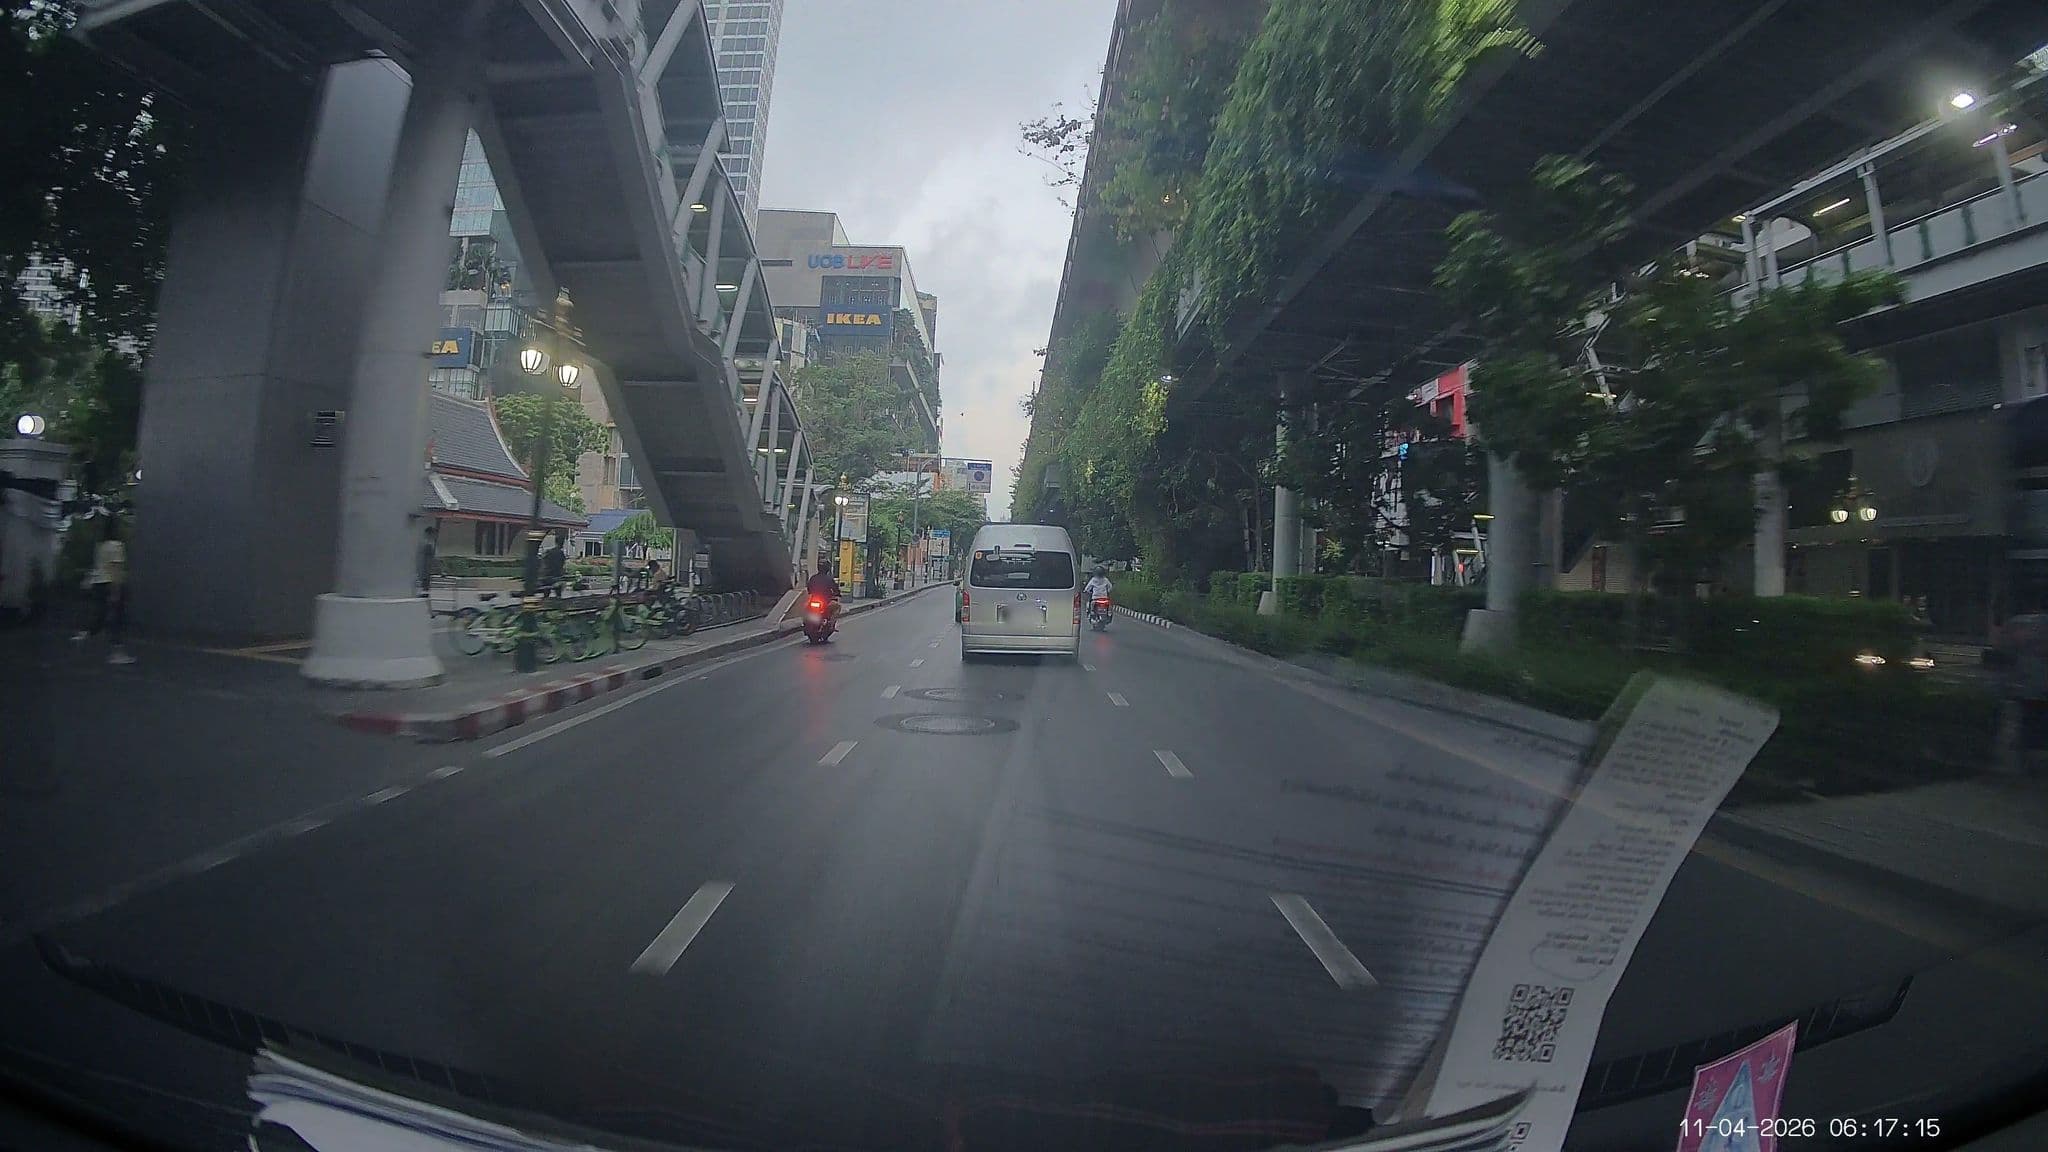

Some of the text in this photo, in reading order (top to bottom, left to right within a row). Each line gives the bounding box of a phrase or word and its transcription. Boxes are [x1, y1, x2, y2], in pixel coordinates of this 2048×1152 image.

[808, 253, 893, 270] UOB LIVE
[827, 313, 882, 325] IKEA
[432, 340, 459, 353] EA
